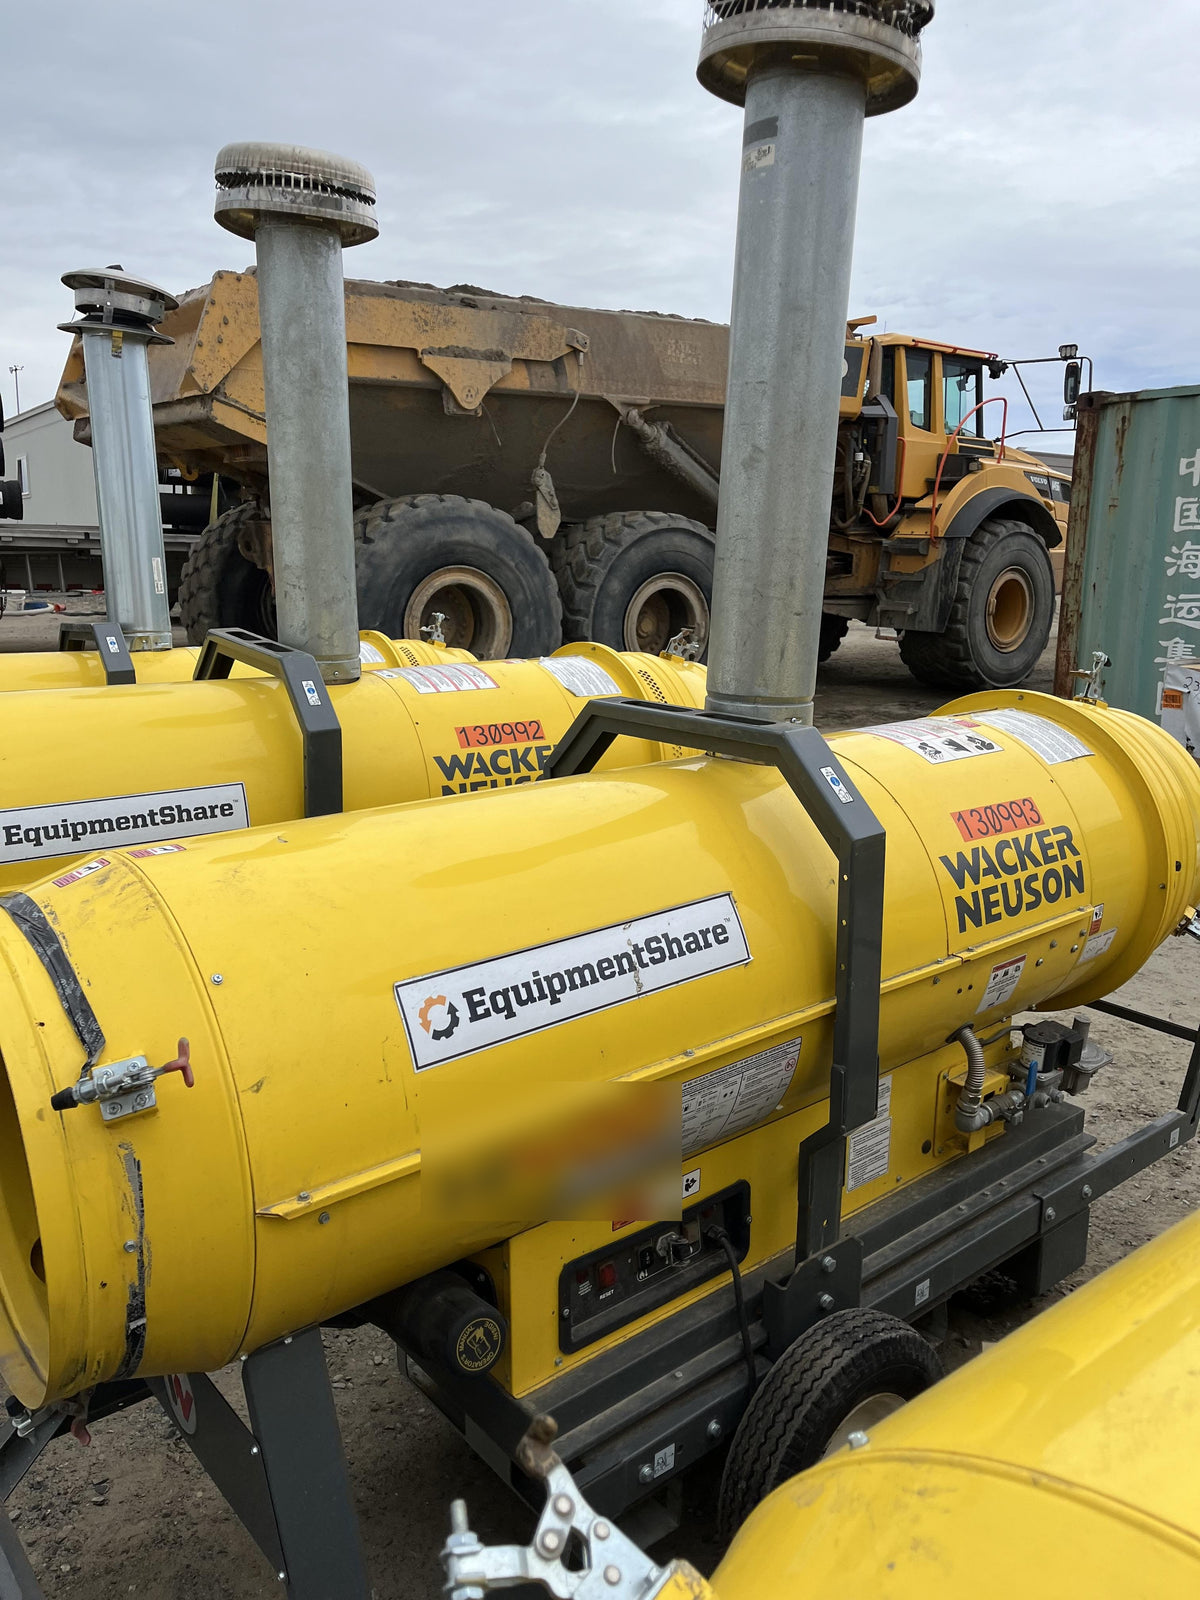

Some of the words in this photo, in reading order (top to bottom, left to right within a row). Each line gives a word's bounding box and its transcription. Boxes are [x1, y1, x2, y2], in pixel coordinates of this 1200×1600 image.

[1153, 448, 1200, 715] 中国海运集
[459, 719, 544, 747] 130992
[432, 743, 559, 782] WACKE
[2, 802, 234, 847] EquipmentShare
[956, 798, 1041, 839] 130993
[938, 825, 1081, 890] WACKER
[954, 860, 1085, 934] NEUSON
[462, 922, 730, 1024] EquipmentShare
